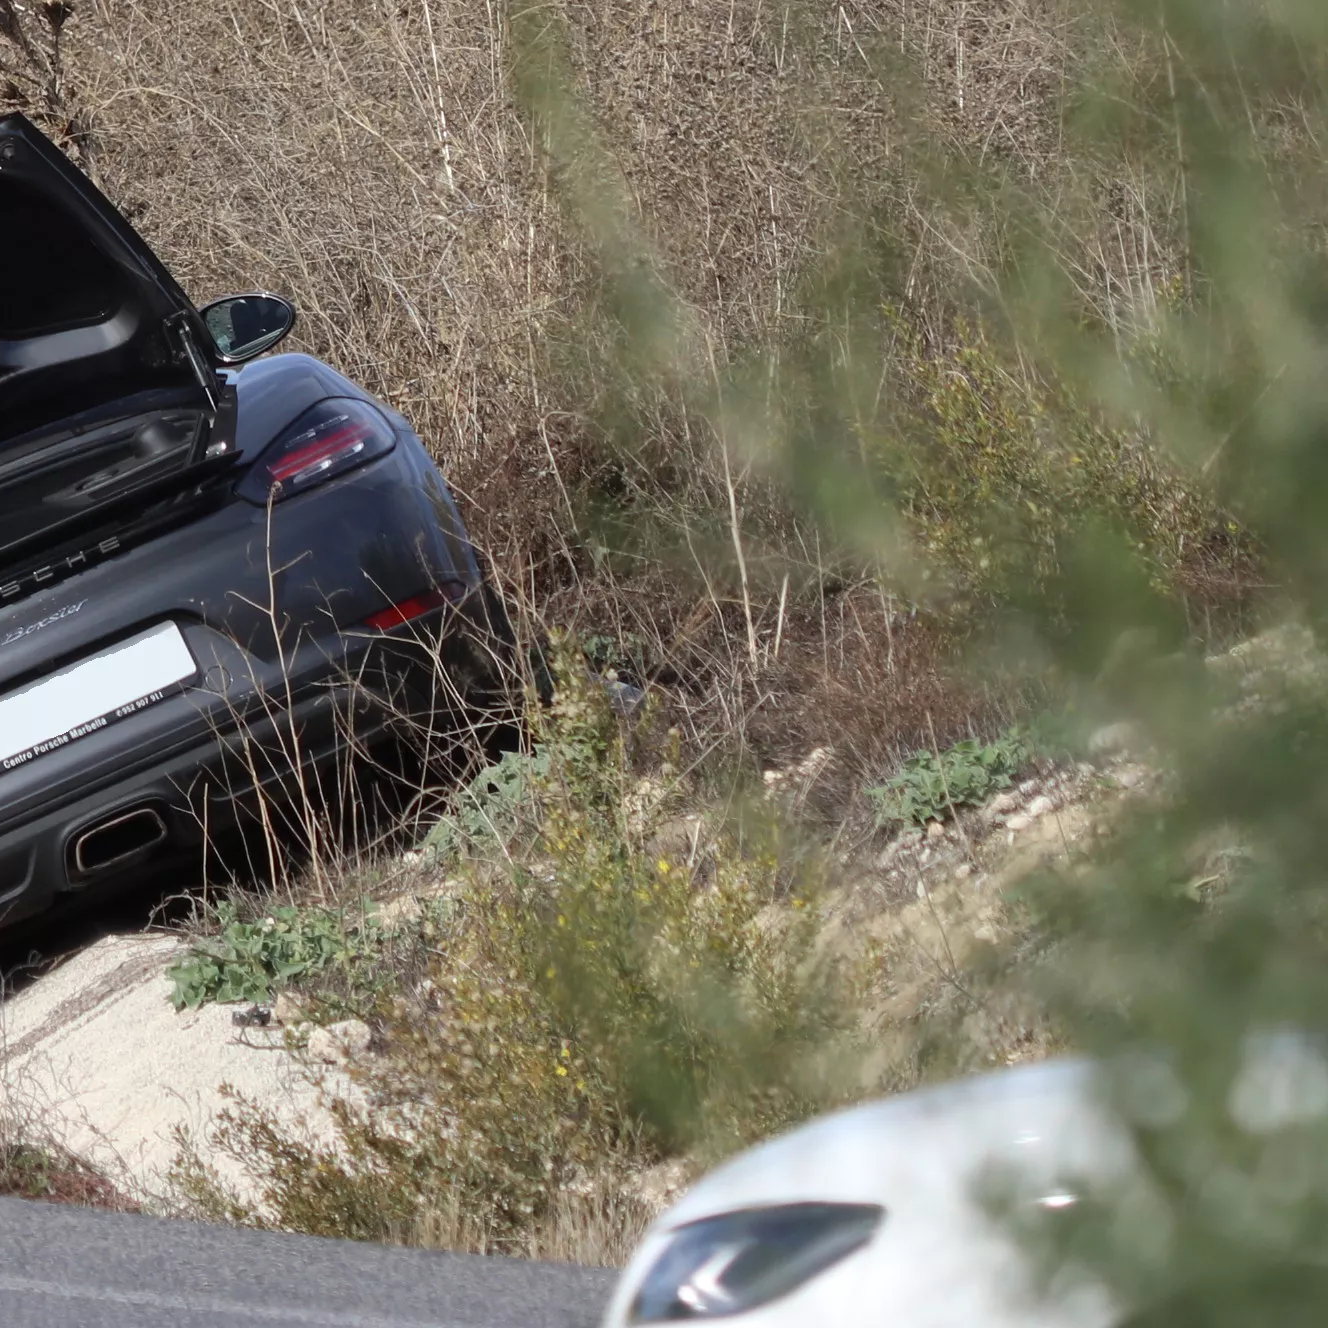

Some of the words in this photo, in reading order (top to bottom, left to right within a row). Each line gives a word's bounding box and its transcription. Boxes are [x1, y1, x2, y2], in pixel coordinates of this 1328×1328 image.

[1, 598, 89, 646] Boxster
[3, 751, 33, 769] Centro
[33, 735, 69, 756] Porsche
[69, 717, 108, 739] Marbella
[135, 697, 149, 709] 907
[150, 691, 163, 702] 911
